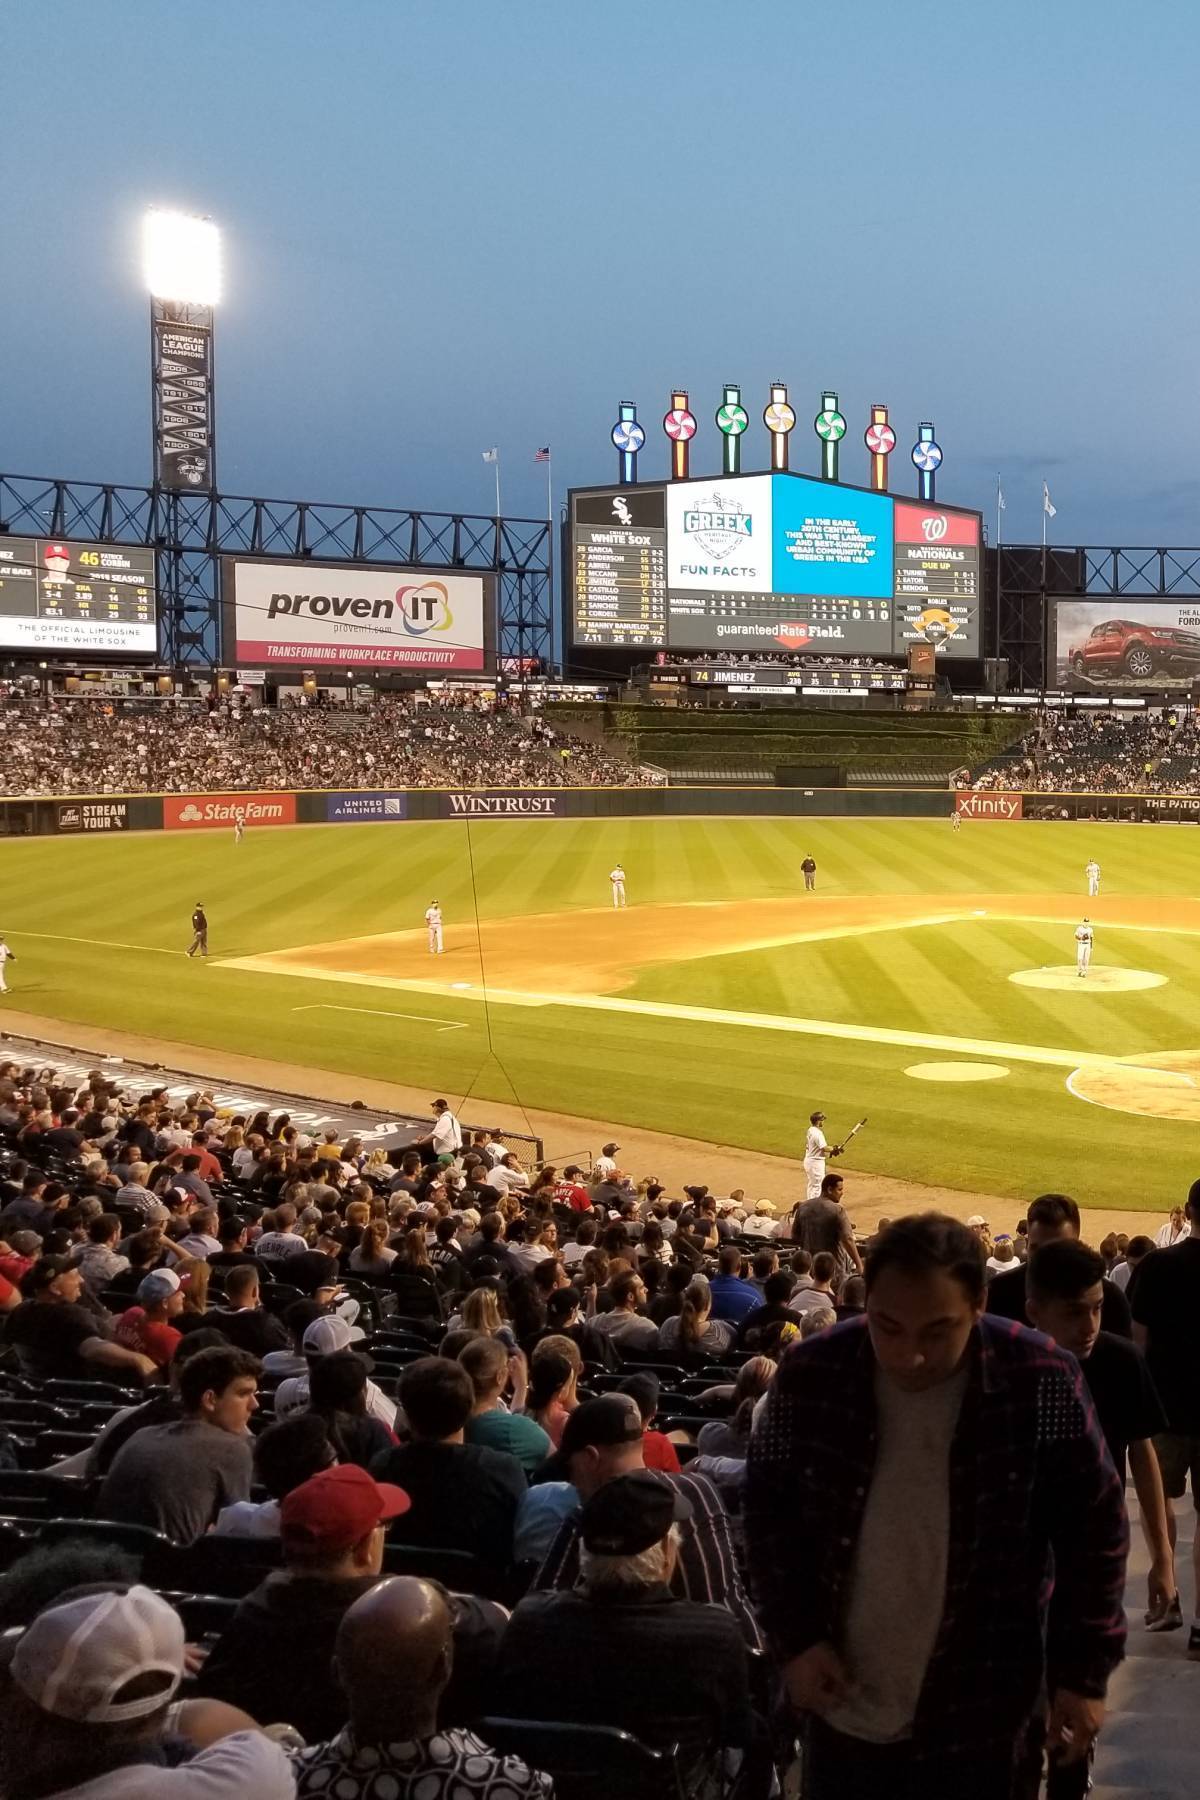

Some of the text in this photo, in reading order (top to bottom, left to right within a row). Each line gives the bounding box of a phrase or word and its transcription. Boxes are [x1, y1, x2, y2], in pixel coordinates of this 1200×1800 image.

[163, 334, 204, 344] AMERICAN
[163, 340, 204, 352] LEAGUE
[163, 349, 204, 359] CHAMPIONS
[685, 511, 751, 535] GREEK
[816, 518, 830, 526] THE
[591, 533, 650, 545] WHITE SOX
[806, 532, 823, 540] WAS
[825, 533, 840, 541] THE
[795, 539, 812, 547] AND
[80, 552, 99, 565] 46
[908, 550, 964, 560] NATIONALS
[680, 565, 756, 577] FUN FACTS
[112, 574, 144, 583] SEASON
[268, 593, 437, 620] proven IT
[853, 609, 860, 620] 0
[869, 610, 875, 620] 1
[881, 610, 888, 620] 0
[588, 621, 613, 629] MANNY
[1178, 617, 1200, 626] FORD
[41, 625, 85, 633] OFFICIAL
[717, 624, 845, 638] guaranteed Rate Field.
[584, 633, 601, 642] 7.11
[633, 635, 643, 643] 47
[652, 636, 662, 644] 72
[268, 645, 455, 662] TRANSFORMING WORKPLACE PRODUCTIVITY
[696, 672, 755, 683] 74 JIMENEZ
[959, 795, 1019, 818] xfinity
[1145, 800, 1200, 809] THE PATIO
[83, 805, 126, 817] STREAM
[83, 817, 111, 828] YOUR
